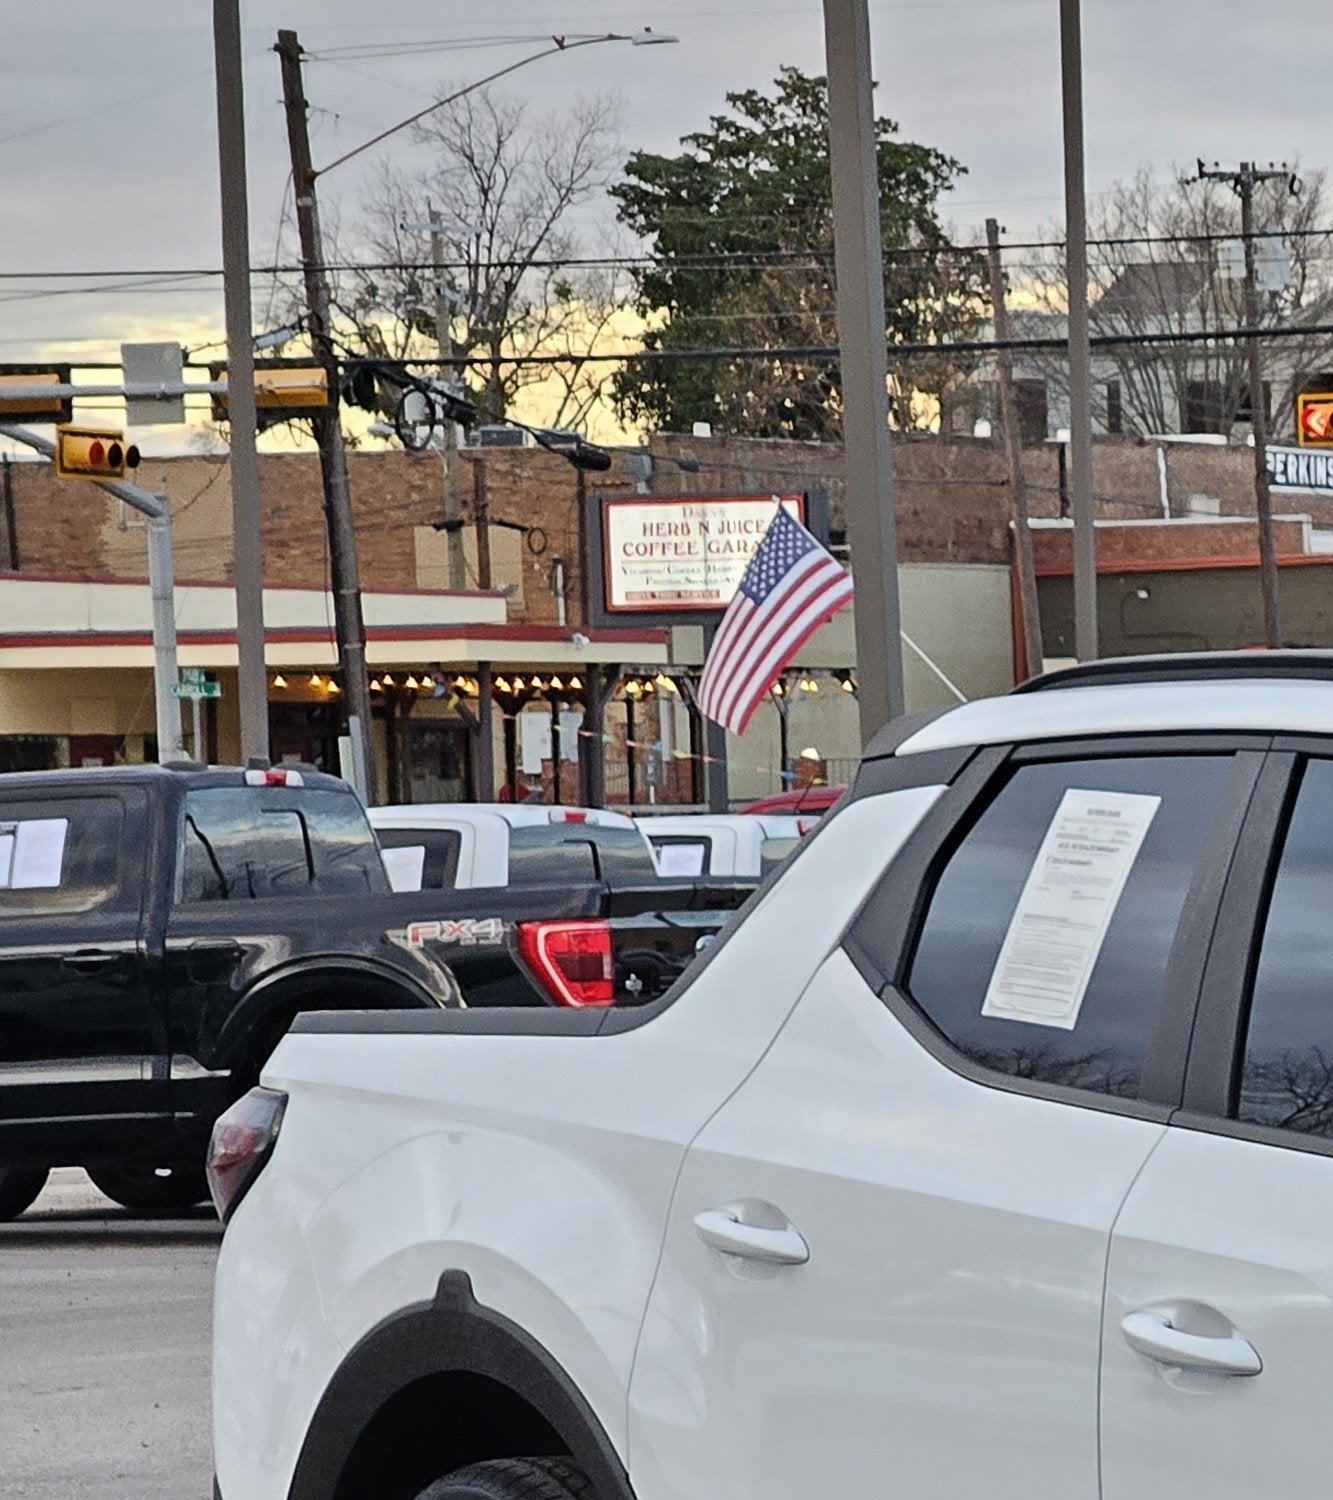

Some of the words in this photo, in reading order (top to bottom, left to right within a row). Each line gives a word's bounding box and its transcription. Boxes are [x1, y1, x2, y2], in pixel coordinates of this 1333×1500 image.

[642, 521, 691, 537] HERB
[698, 520, 711, 536] N
[717, 518, 766, 535] JUICE
[622, 541, 700, 557] COFFEE
[707, 539, 761, 554] GARA
[407, 917, 503, 948] FX4
